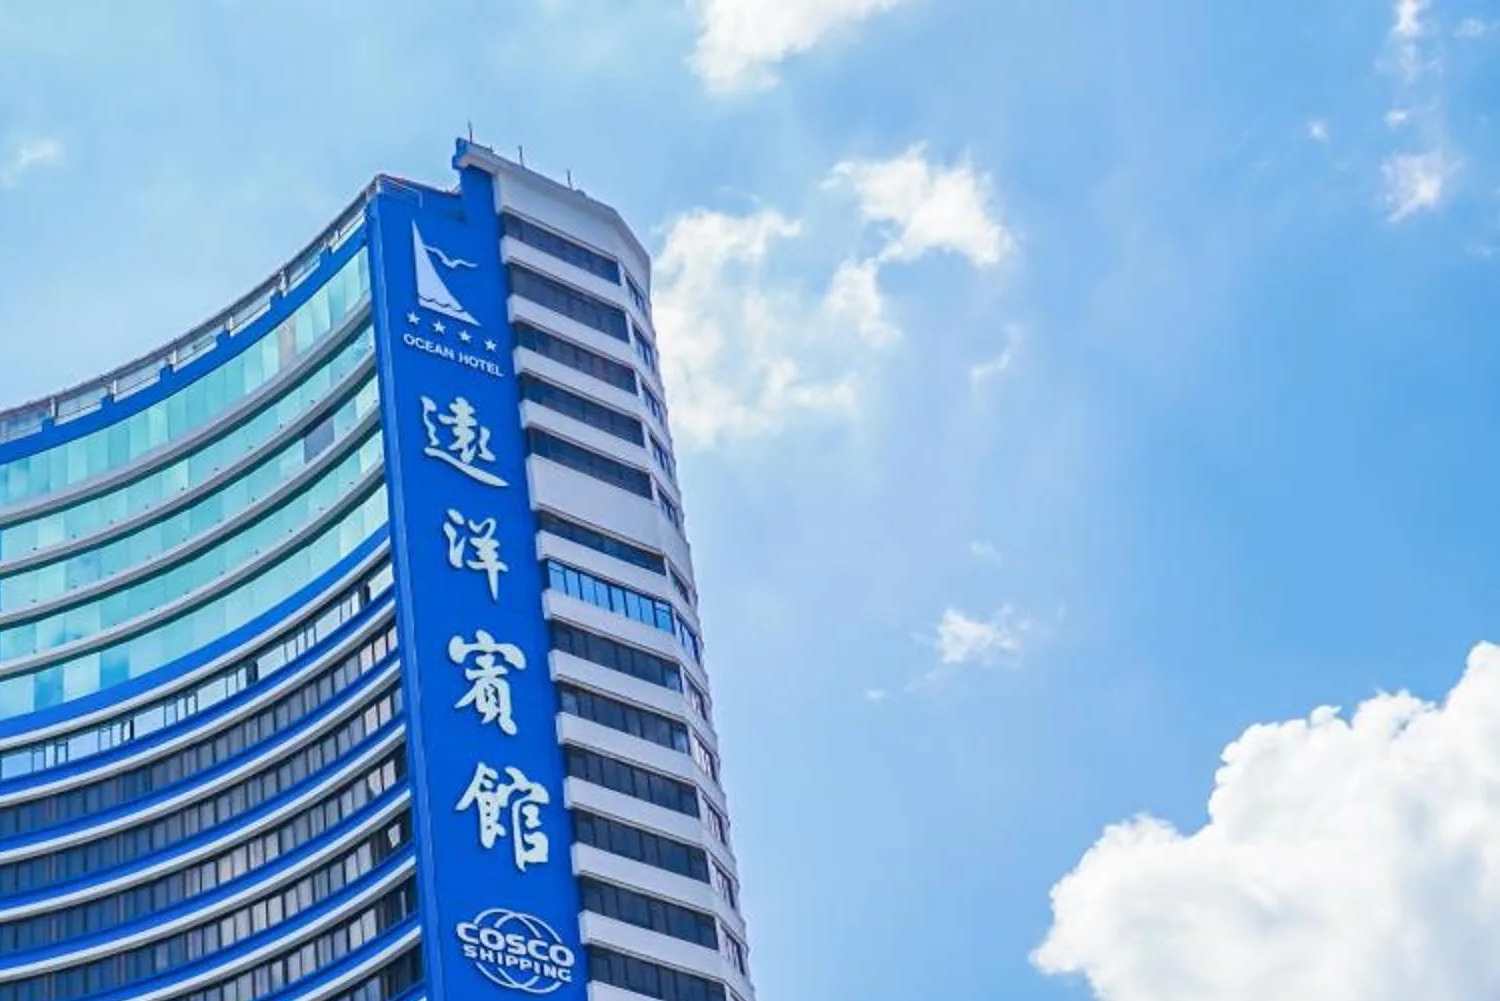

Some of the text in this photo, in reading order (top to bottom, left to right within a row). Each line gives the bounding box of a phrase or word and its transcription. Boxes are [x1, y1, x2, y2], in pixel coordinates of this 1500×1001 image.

[403, 333, 505, 377] OCEAN HOTEL
[456, 922, 575, 967] COSCO
[463, 943, 572, 982] SHIPPING
